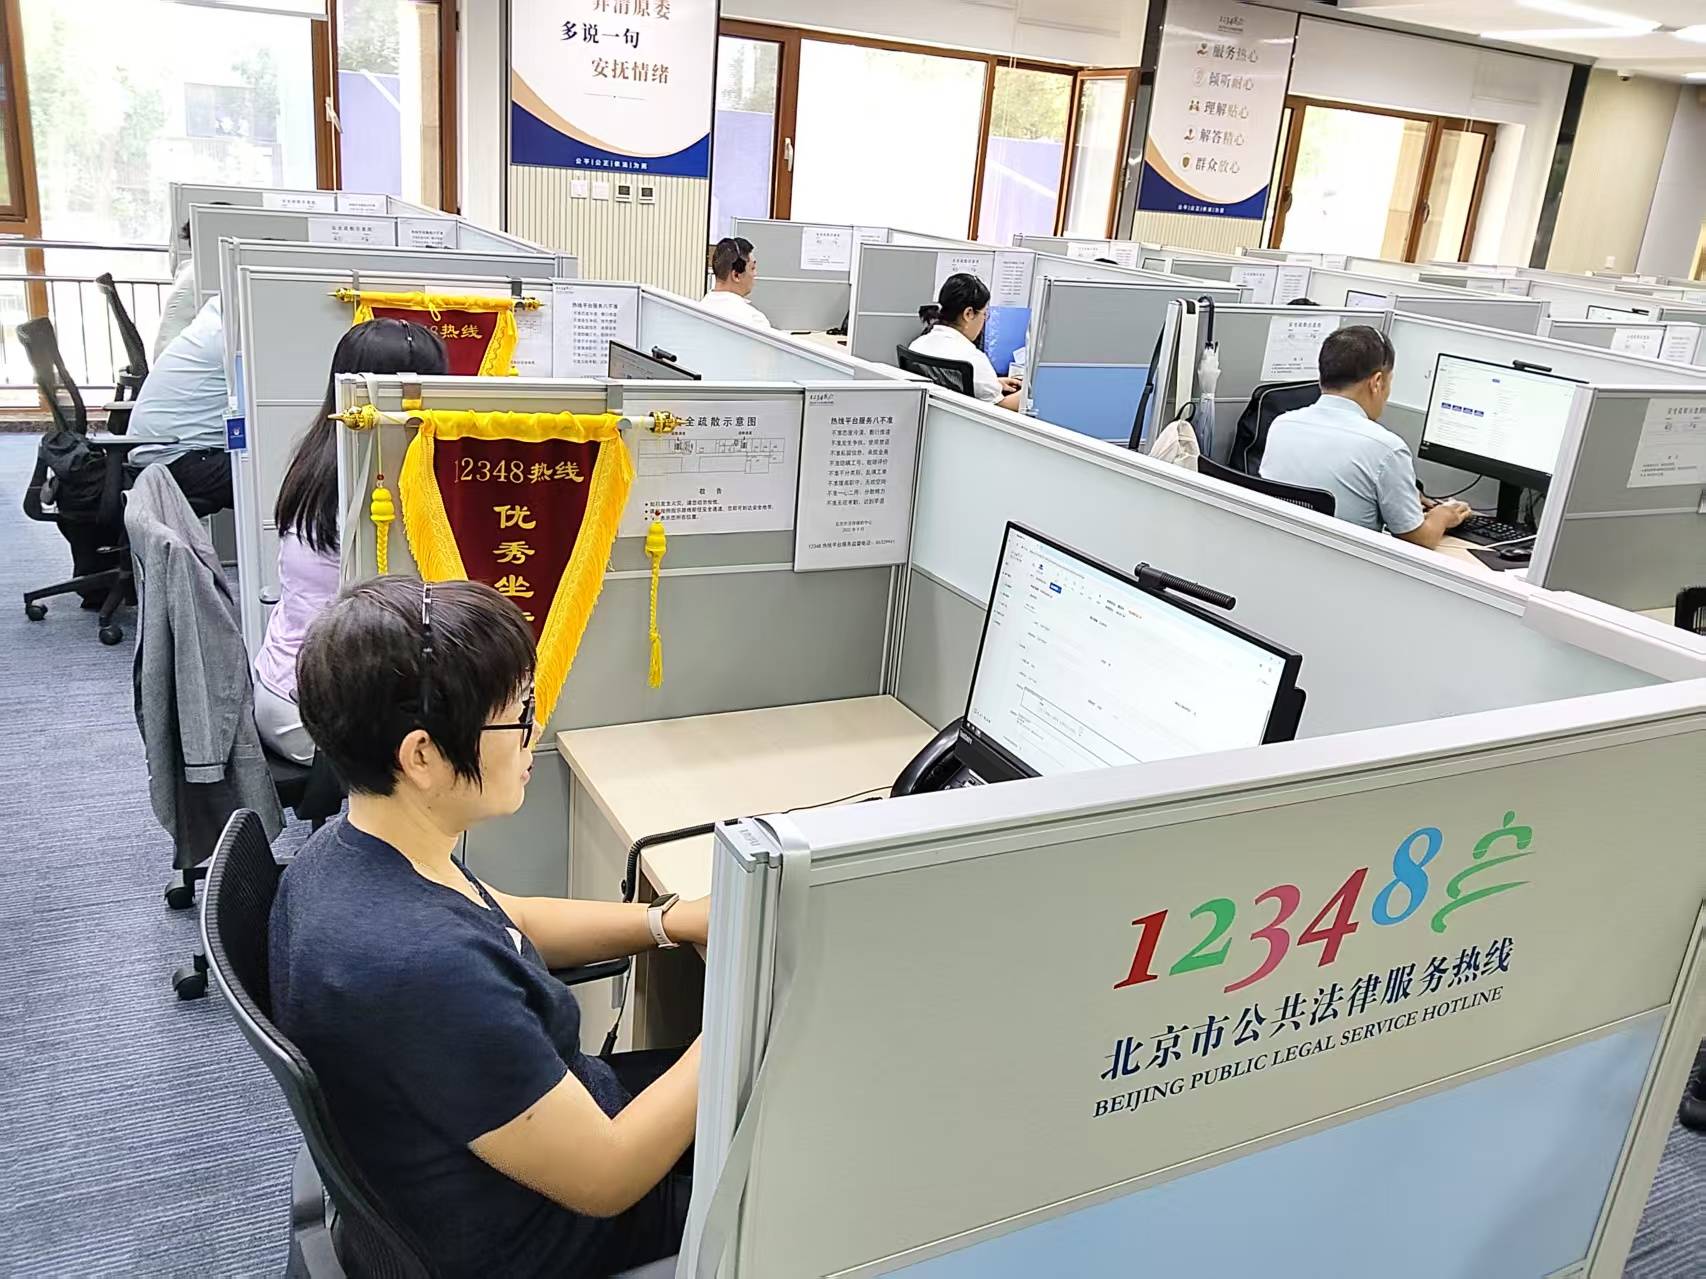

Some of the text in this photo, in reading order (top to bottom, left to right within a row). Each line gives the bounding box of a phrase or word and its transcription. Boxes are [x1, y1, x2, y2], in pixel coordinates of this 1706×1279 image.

[560, 20, 641, 49] 多说一句
[1212, 45, 1259, 63] 服务热心
[591, 57, 670, 85] 安抚情绪
[1208, 72, 1255, 91] 倾听耐心
[1204, 101, 1249, 119] 理解贴心
[1199, 128, 1245, 146] 解答精心
[1195, 157, 1241, 174] 群众放心
[424, 324, 483, 339] 8热线
[677, 416, 757, 428] 全疏散示意图
[830, 416, 893, 425] 热线平台服务八不准
[454, 457, 585, 484] 12348热线
[493, 505, 537, 622] 优秀坐
[1113, 826, 1443, 994] 12348
[1099, 937, 1514, 1081] 北京市公共法律服务热线
[1092, 985, 1504, 1118] BEIJING PUBLIC LEGAL SERVICE HOTLINE
